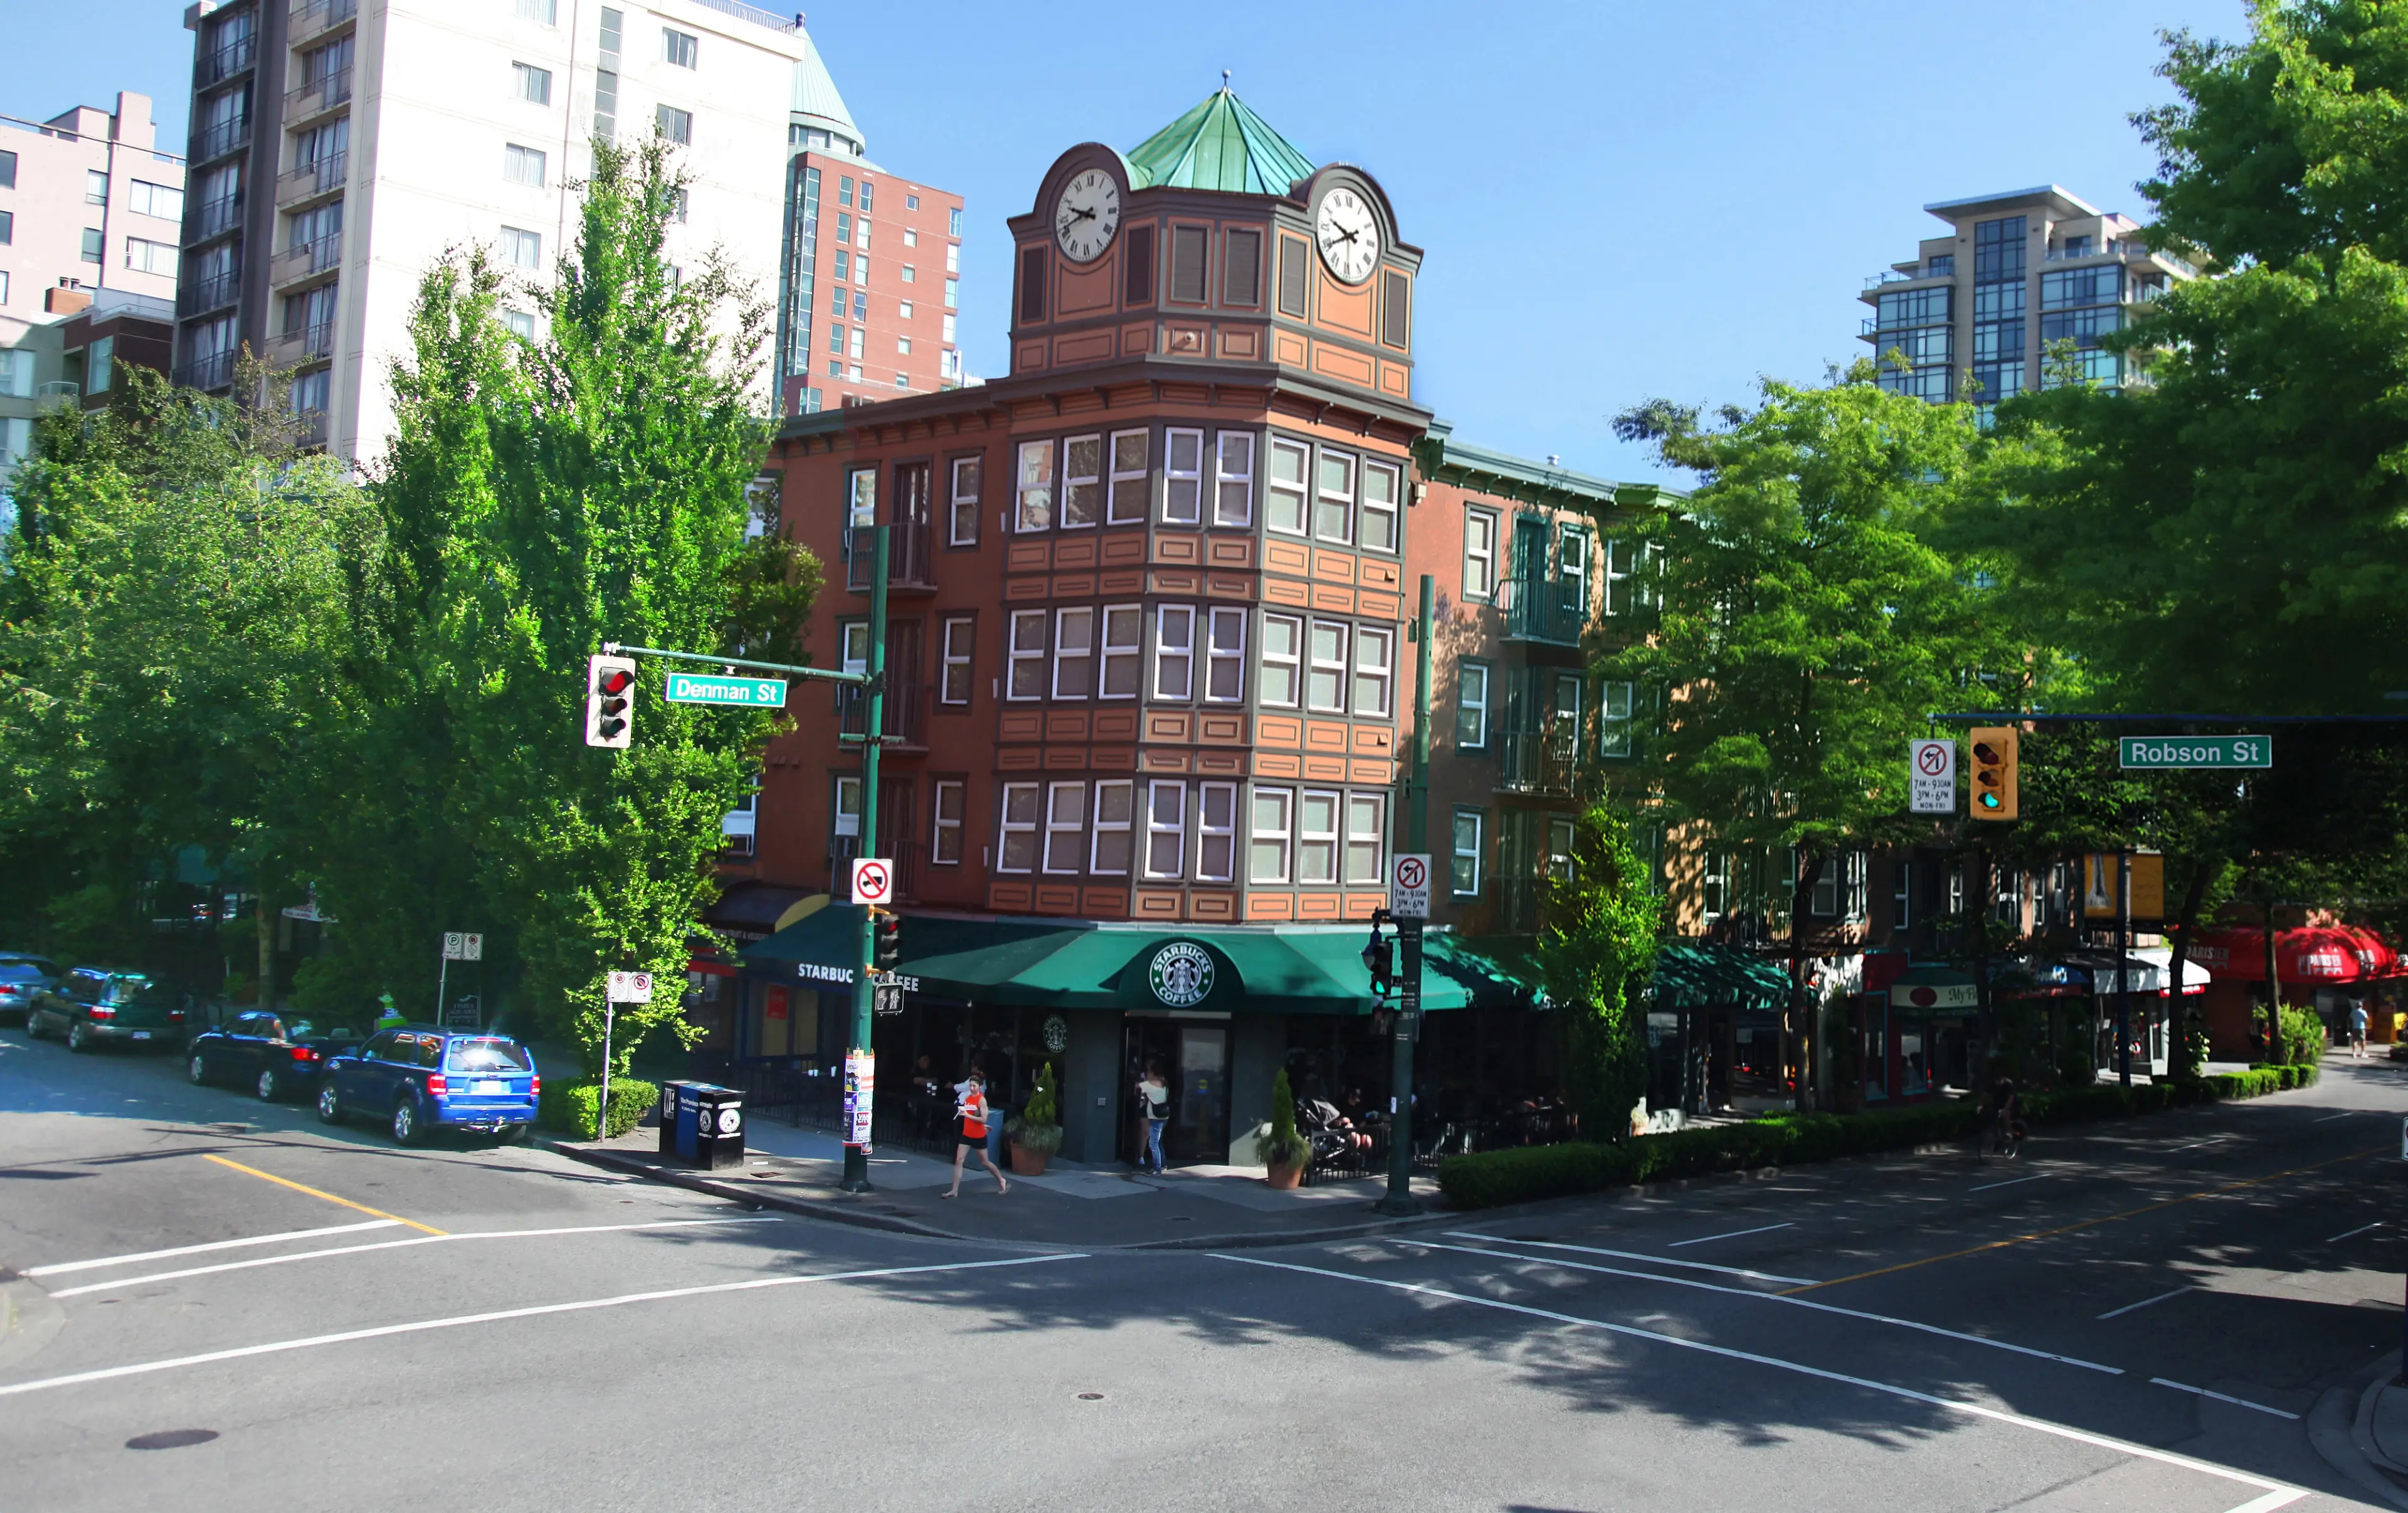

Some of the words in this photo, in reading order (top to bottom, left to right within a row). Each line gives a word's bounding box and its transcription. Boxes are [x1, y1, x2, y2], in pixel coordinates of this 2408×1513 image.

[676, 678, 749, 701] Denman
[757, 683, 778, 702] St
[2132, 743, 2221, 762] Robson
[2232, 741, 2259, 762] St
[1916, 791, 1930, 801] 3PM
[1935, 791, 1948, 801] 6PM
[1154, 945, 1211, 973] STARBUCKS
[798, 963, 853, 984] STARBUC
[1159, 986, 1202, 1004] COFFEE
[1047, 1040, 1064, 1051] COFFEE
